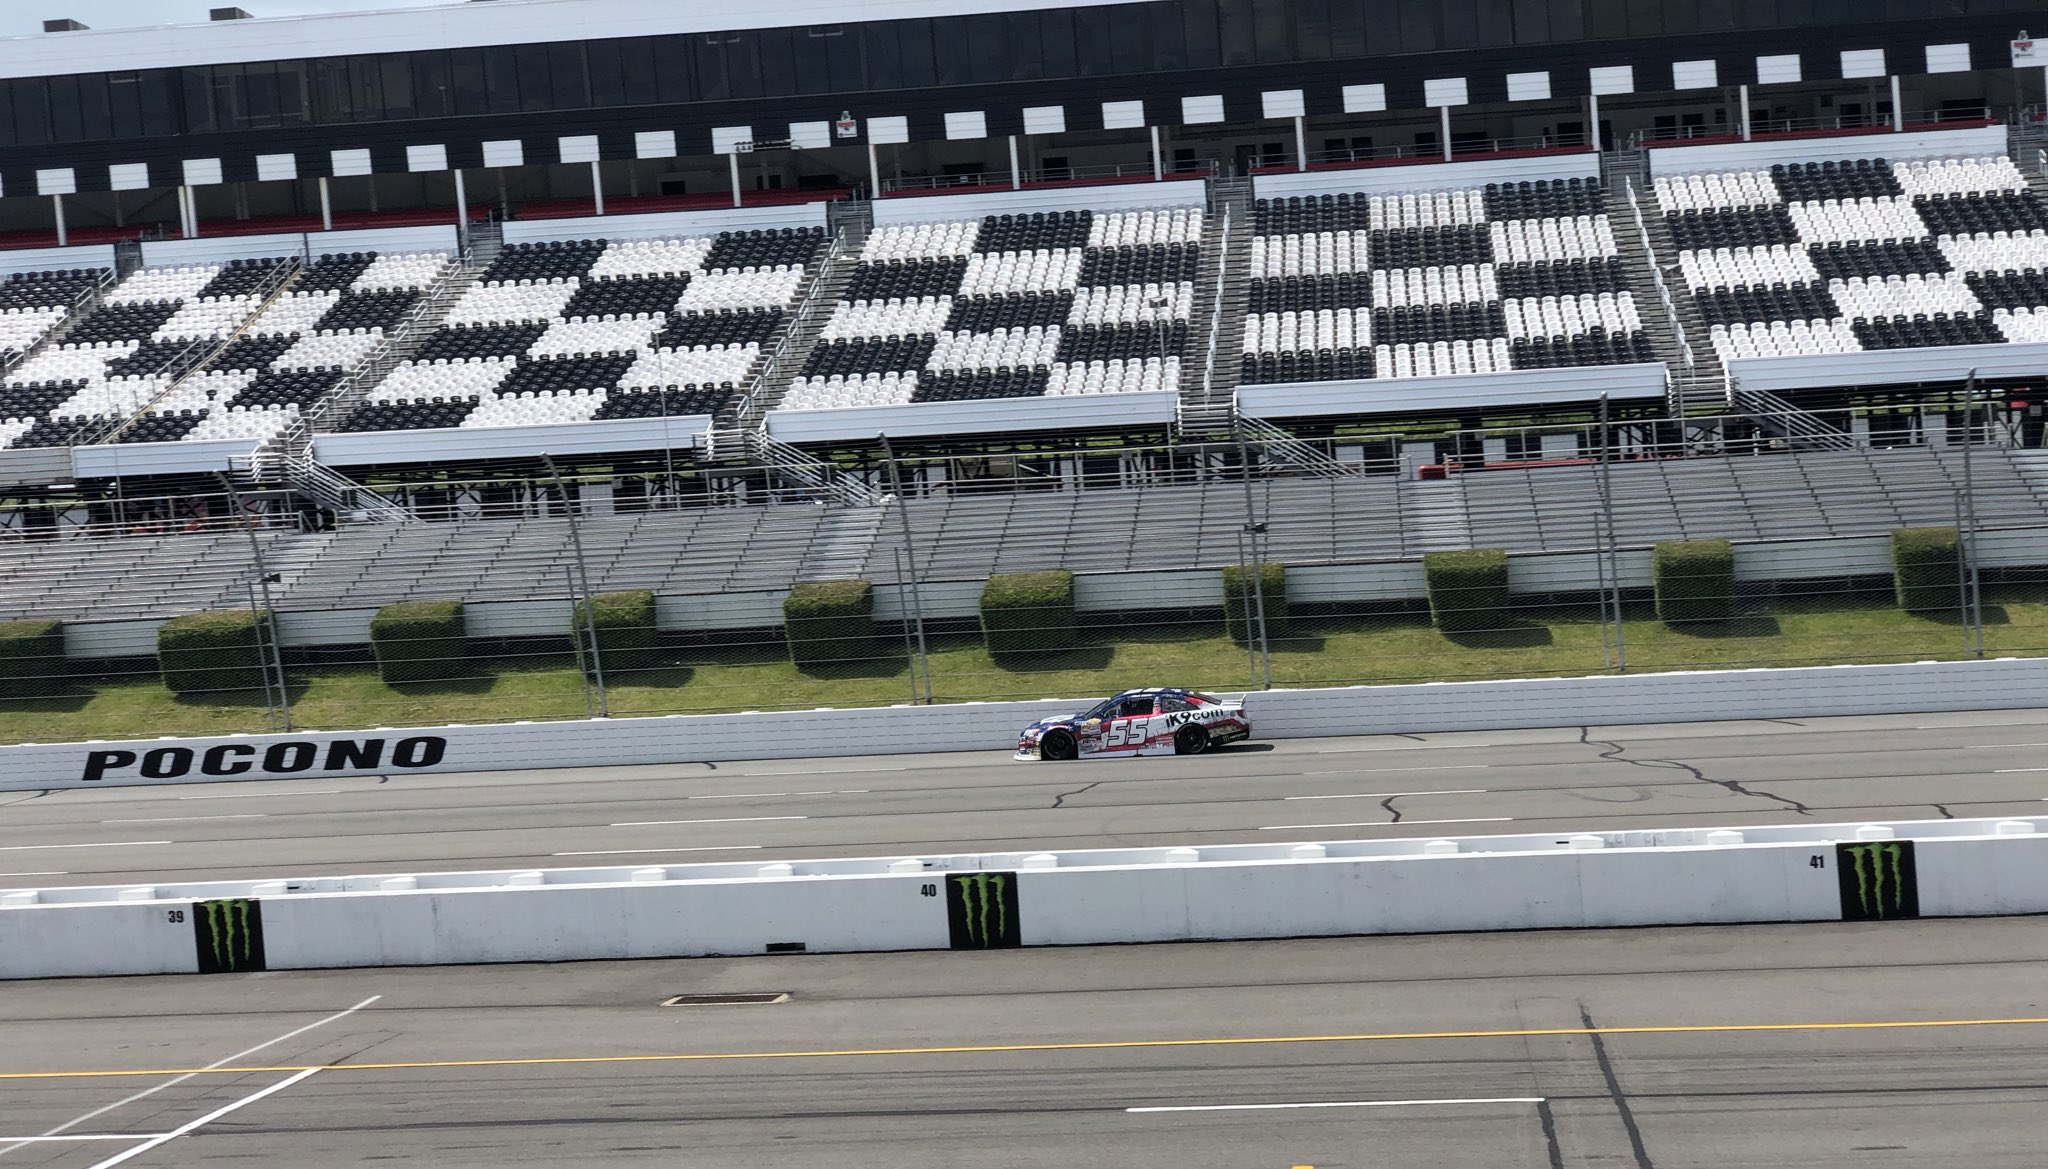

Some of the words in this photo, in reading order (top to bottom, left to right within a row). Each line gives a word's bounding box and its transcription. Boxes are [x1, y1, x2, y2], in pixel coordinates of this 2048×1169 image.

[1107, 718, 1149, 747] 55
[82, 736, 447, 781] POCONO
[1809, 855, 1825, 869] 41
[921, 884, 937, 898] 40
[168, 910, 184, 923] 39
